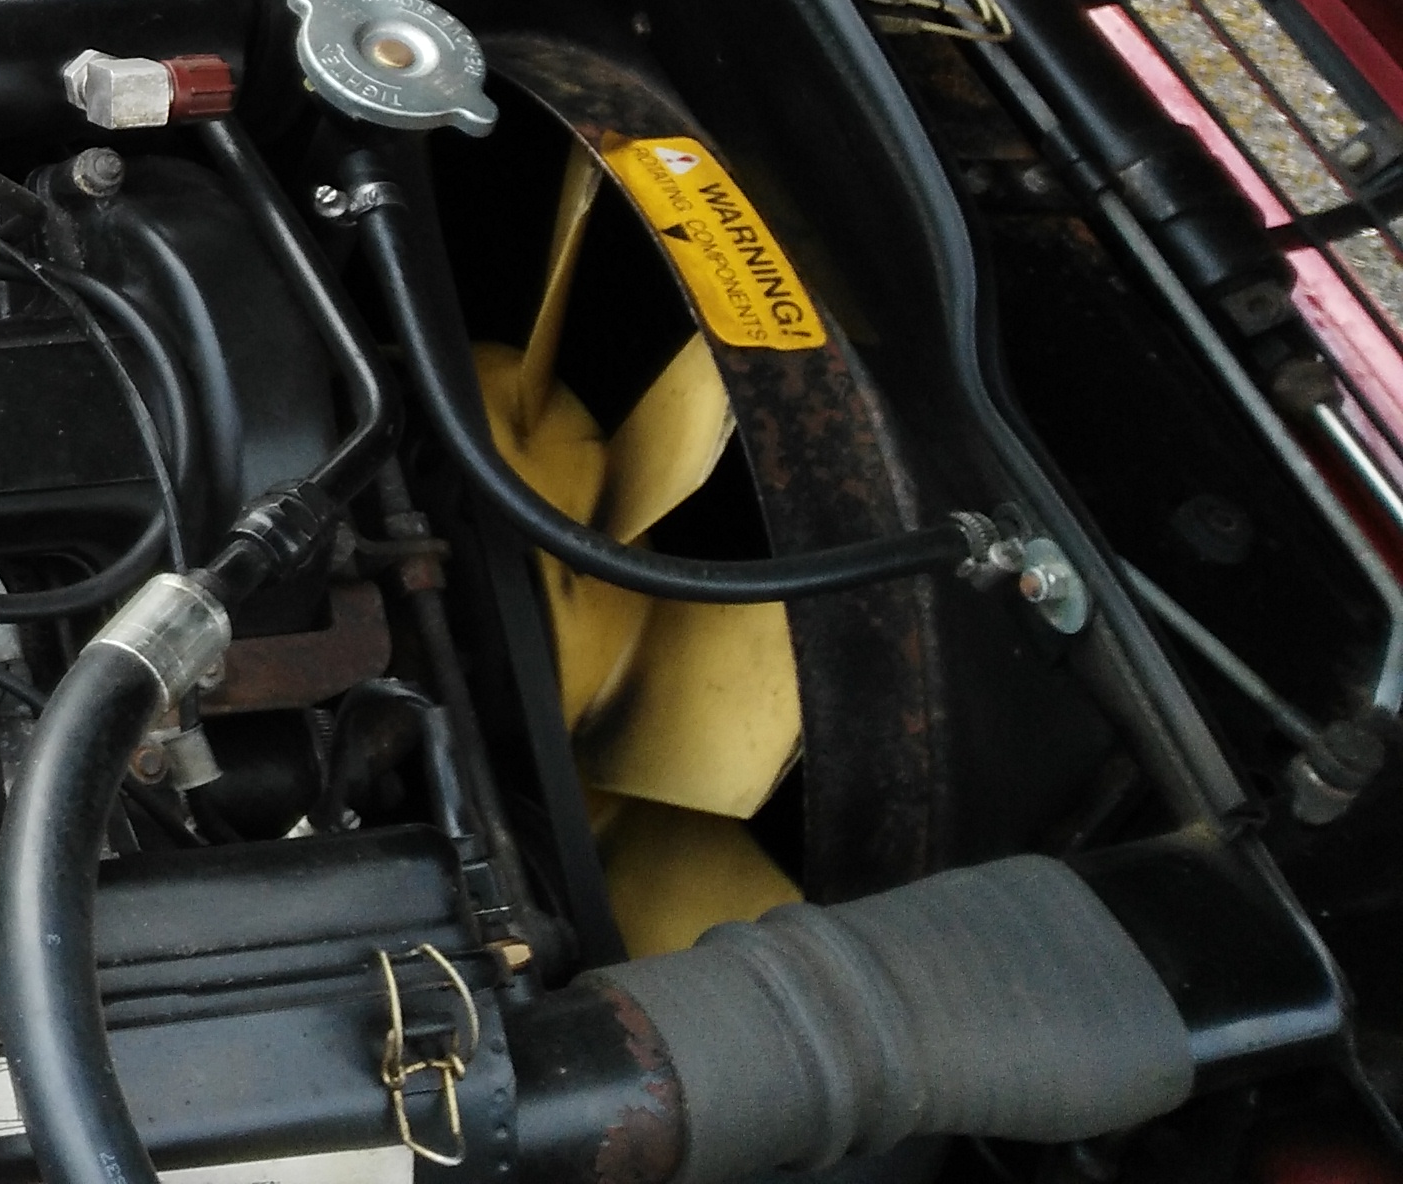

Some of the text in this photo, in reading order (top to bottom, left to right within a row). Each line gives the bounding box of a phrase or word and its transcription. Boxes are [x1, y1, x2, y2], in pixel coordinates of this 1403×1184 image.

[634, 147, 769, 342] ROTATING COMPONENTS
[698, 181, 812, 339] WARNING!
